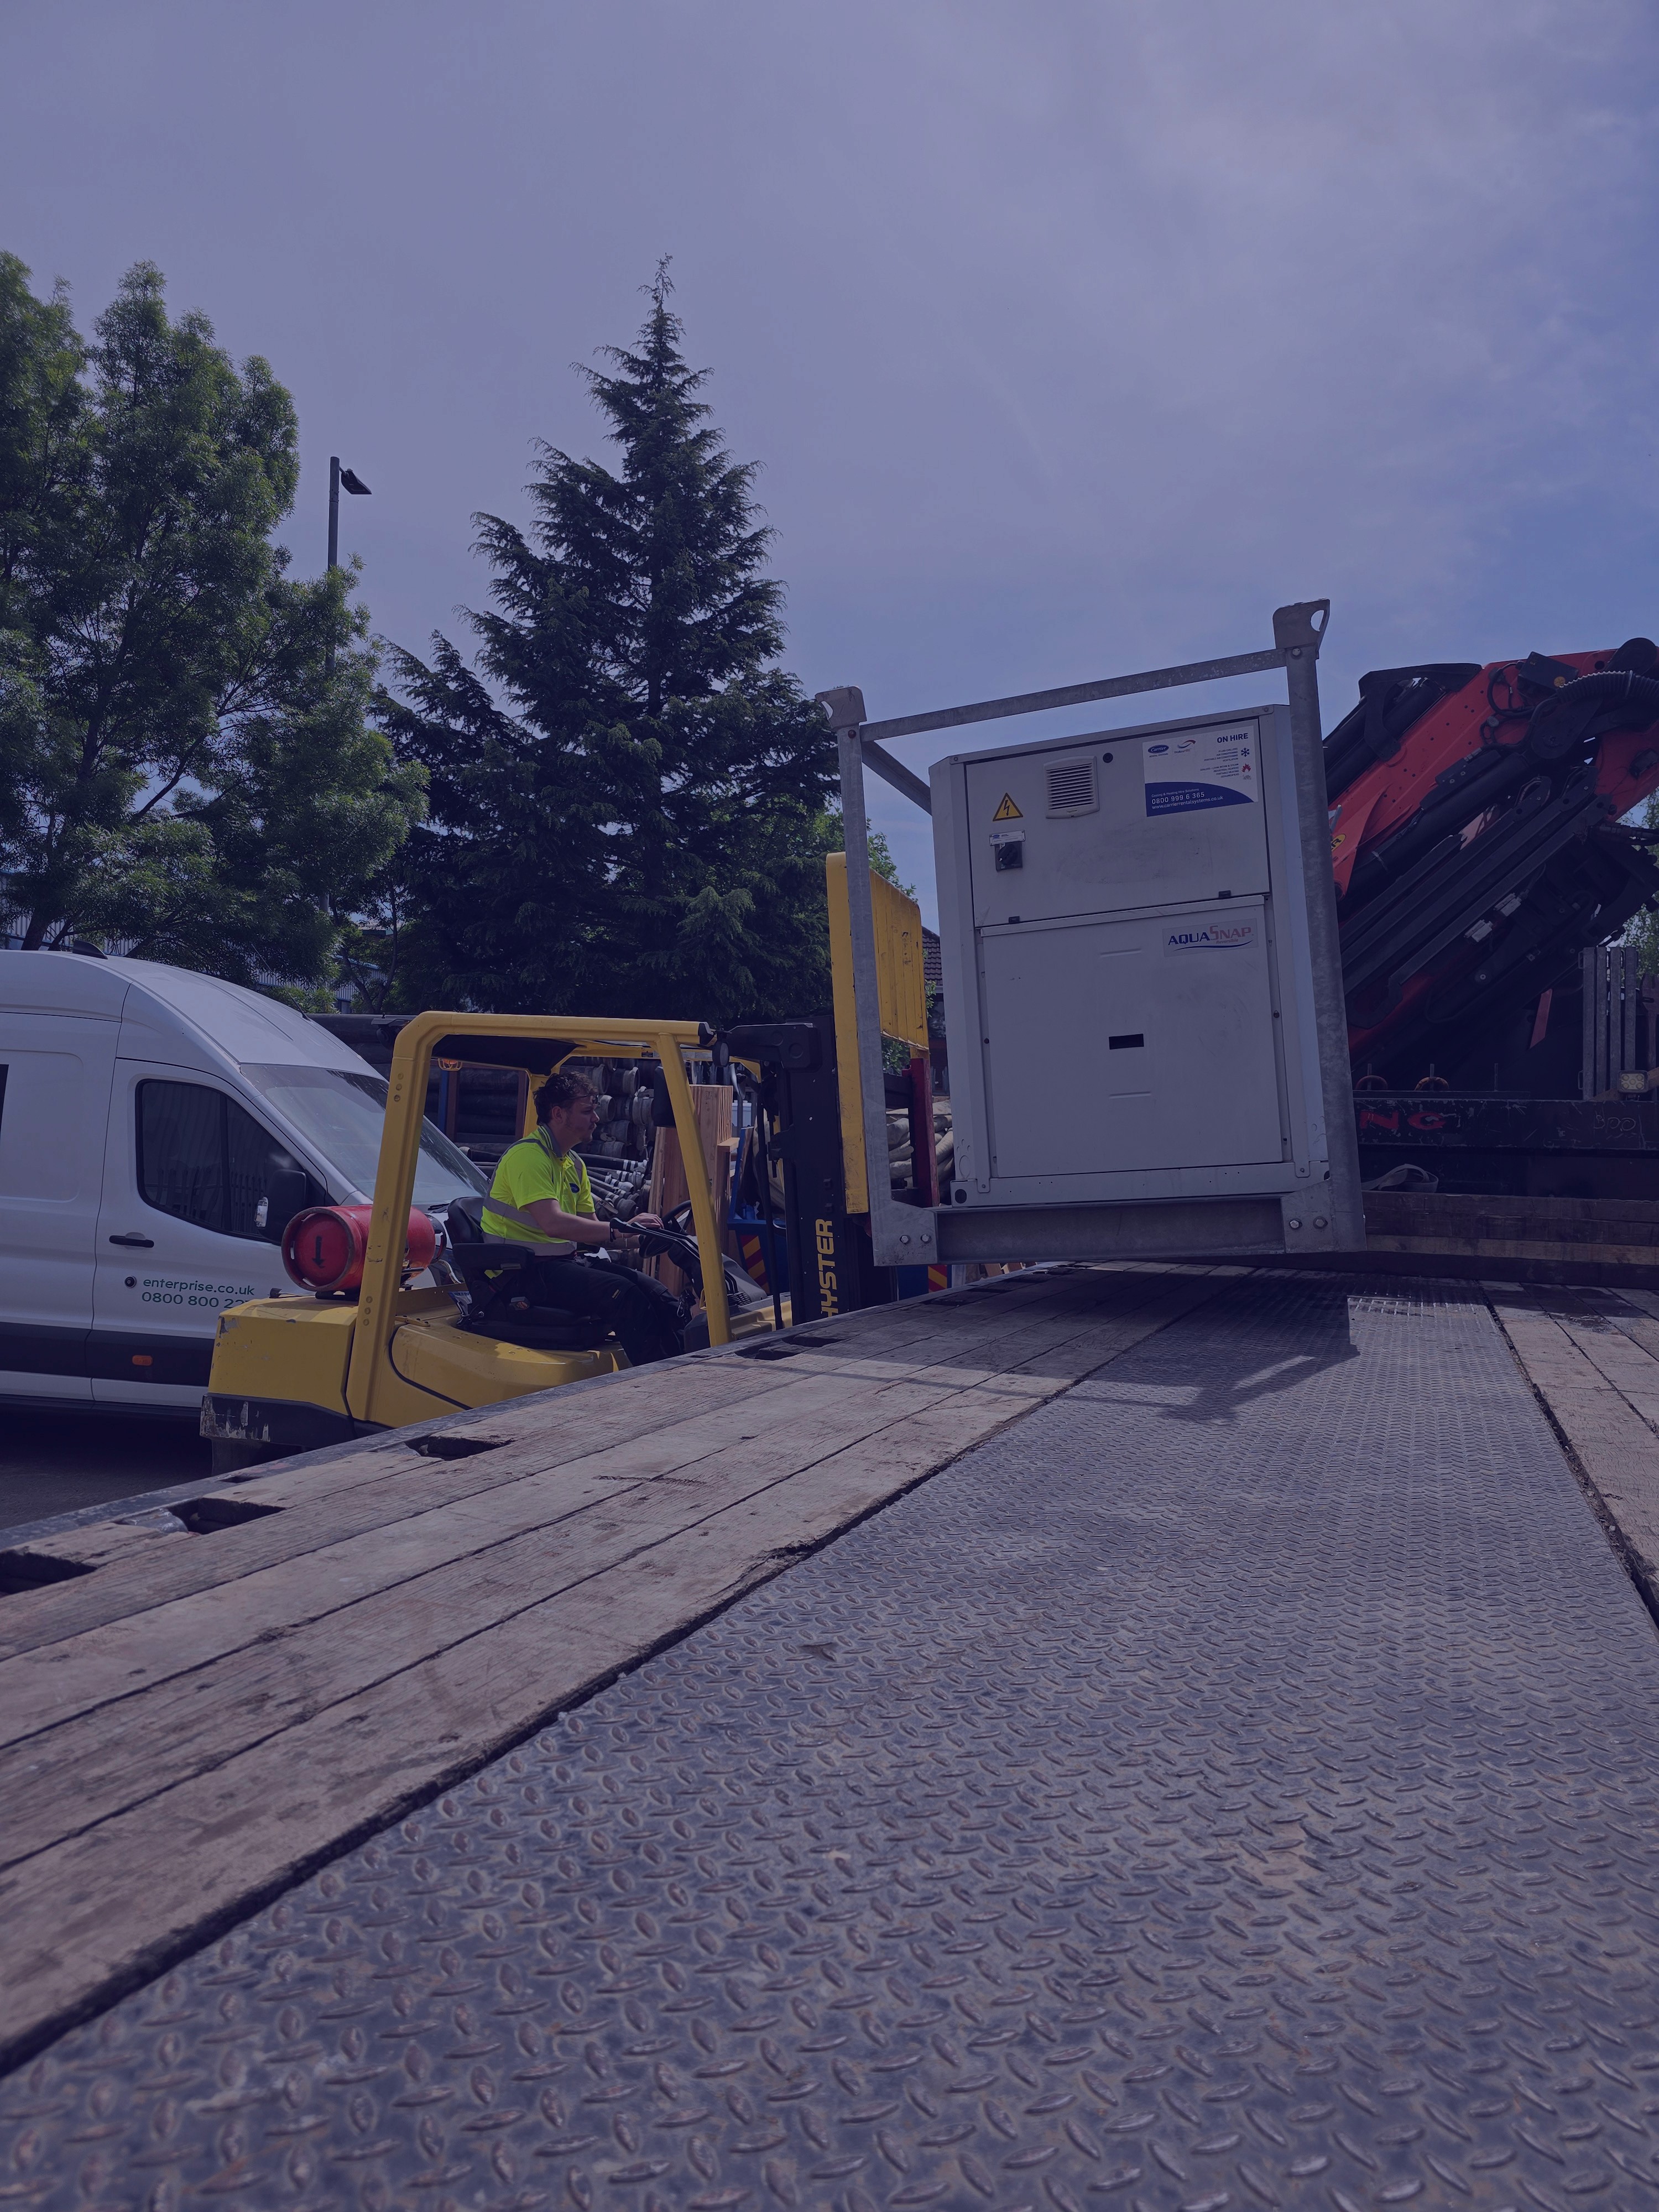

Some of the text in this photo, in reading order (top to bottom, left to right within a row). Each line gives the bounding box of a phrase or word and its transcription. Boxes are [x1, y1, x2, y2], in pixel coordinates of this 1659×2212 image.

[1230, 733, 1249, 742] HIRE
[1152, 795, 1224, 810] www.carrierrentalsystems.co.uk
[143, 1279, 255, 1296] enterprise.co.uk
[142, 1292, 249, 1308] 0800 800 22
